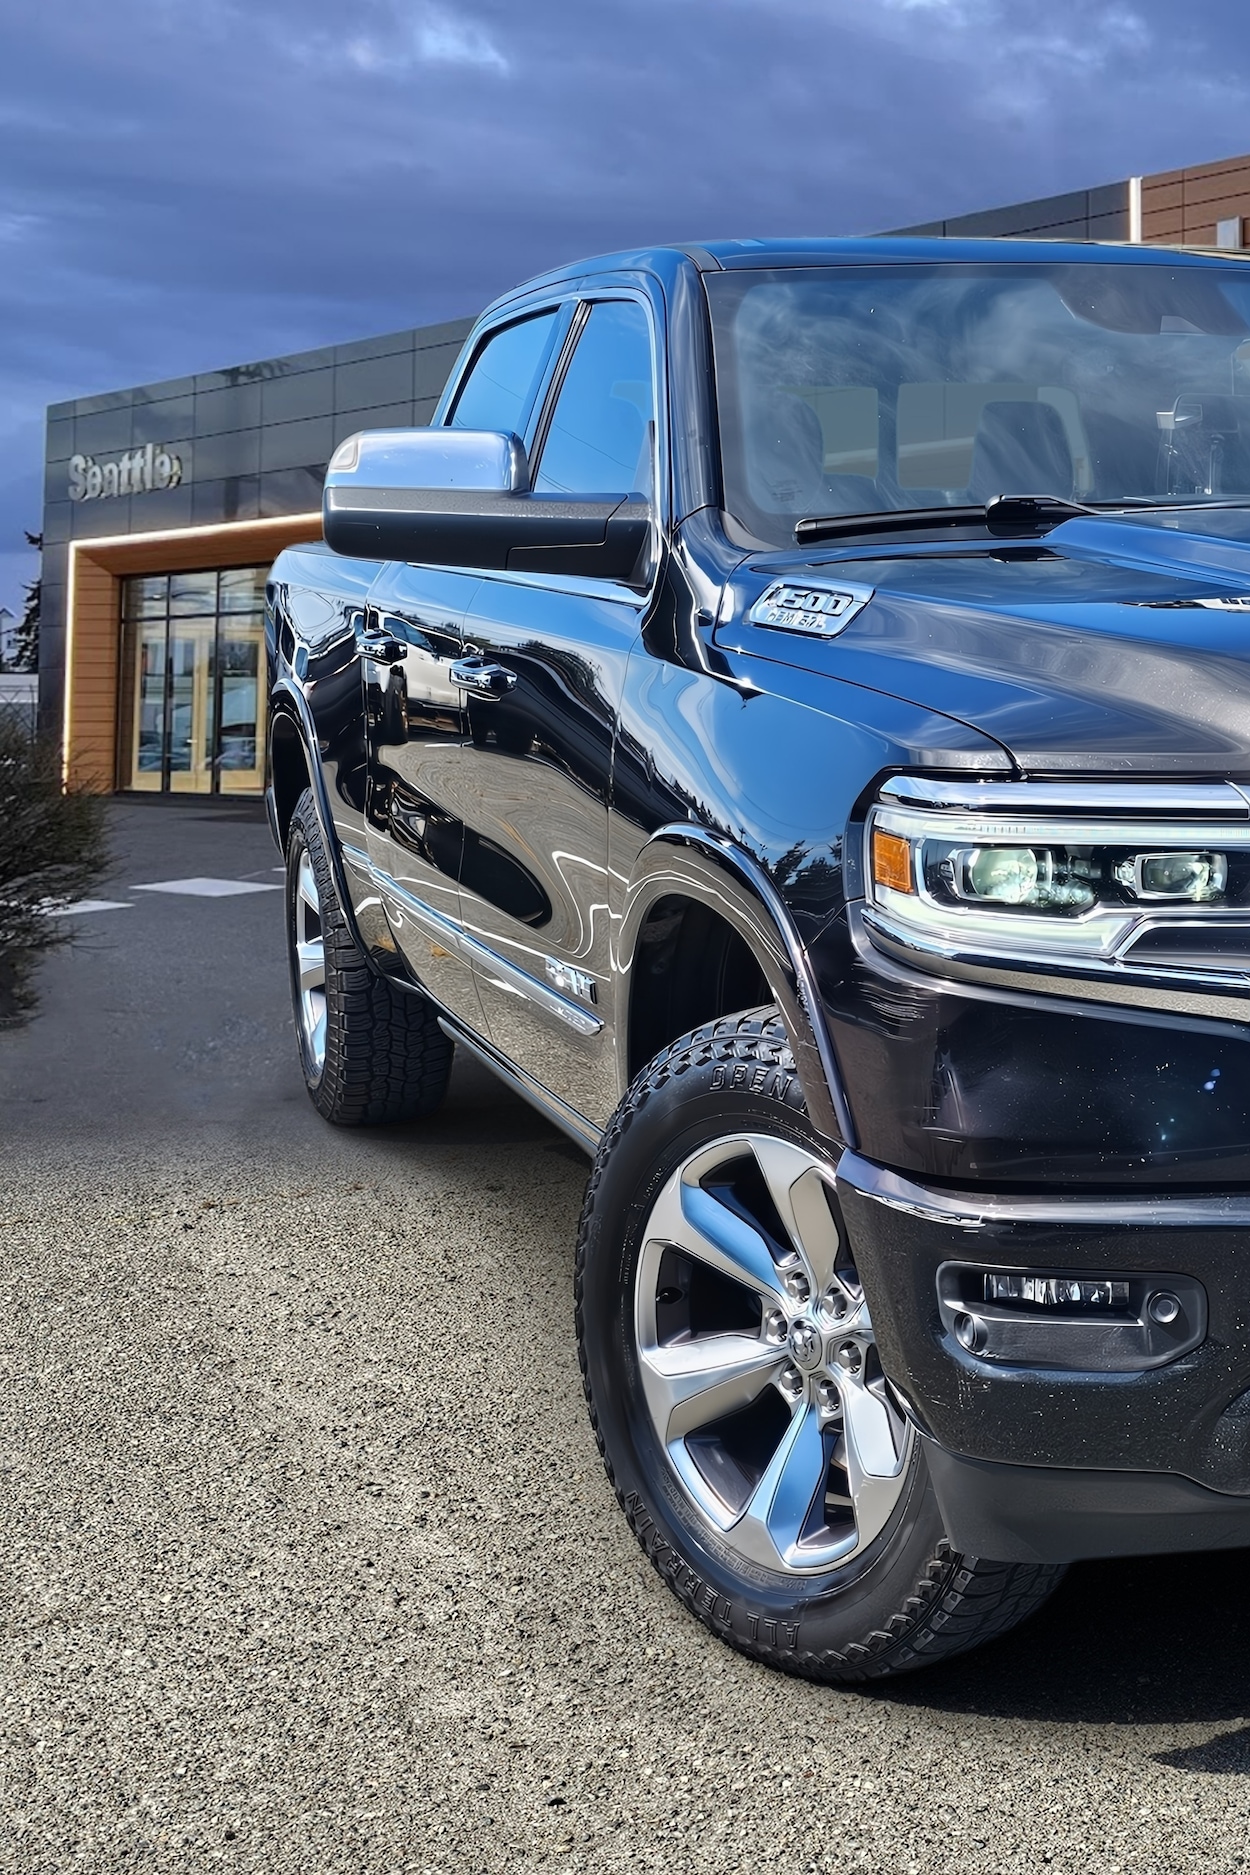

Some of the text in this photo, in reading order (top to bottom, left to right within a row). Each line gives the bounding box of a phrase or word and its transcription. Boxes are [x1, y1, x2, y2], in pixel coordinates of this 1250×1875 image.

[68, 443, 175, 500] Seattle
[709, 1063, 794, 1101] OPEN
[625, 1490, 732, 1627] TERRAIN
[747, 1612, 800, 1648] ALL
